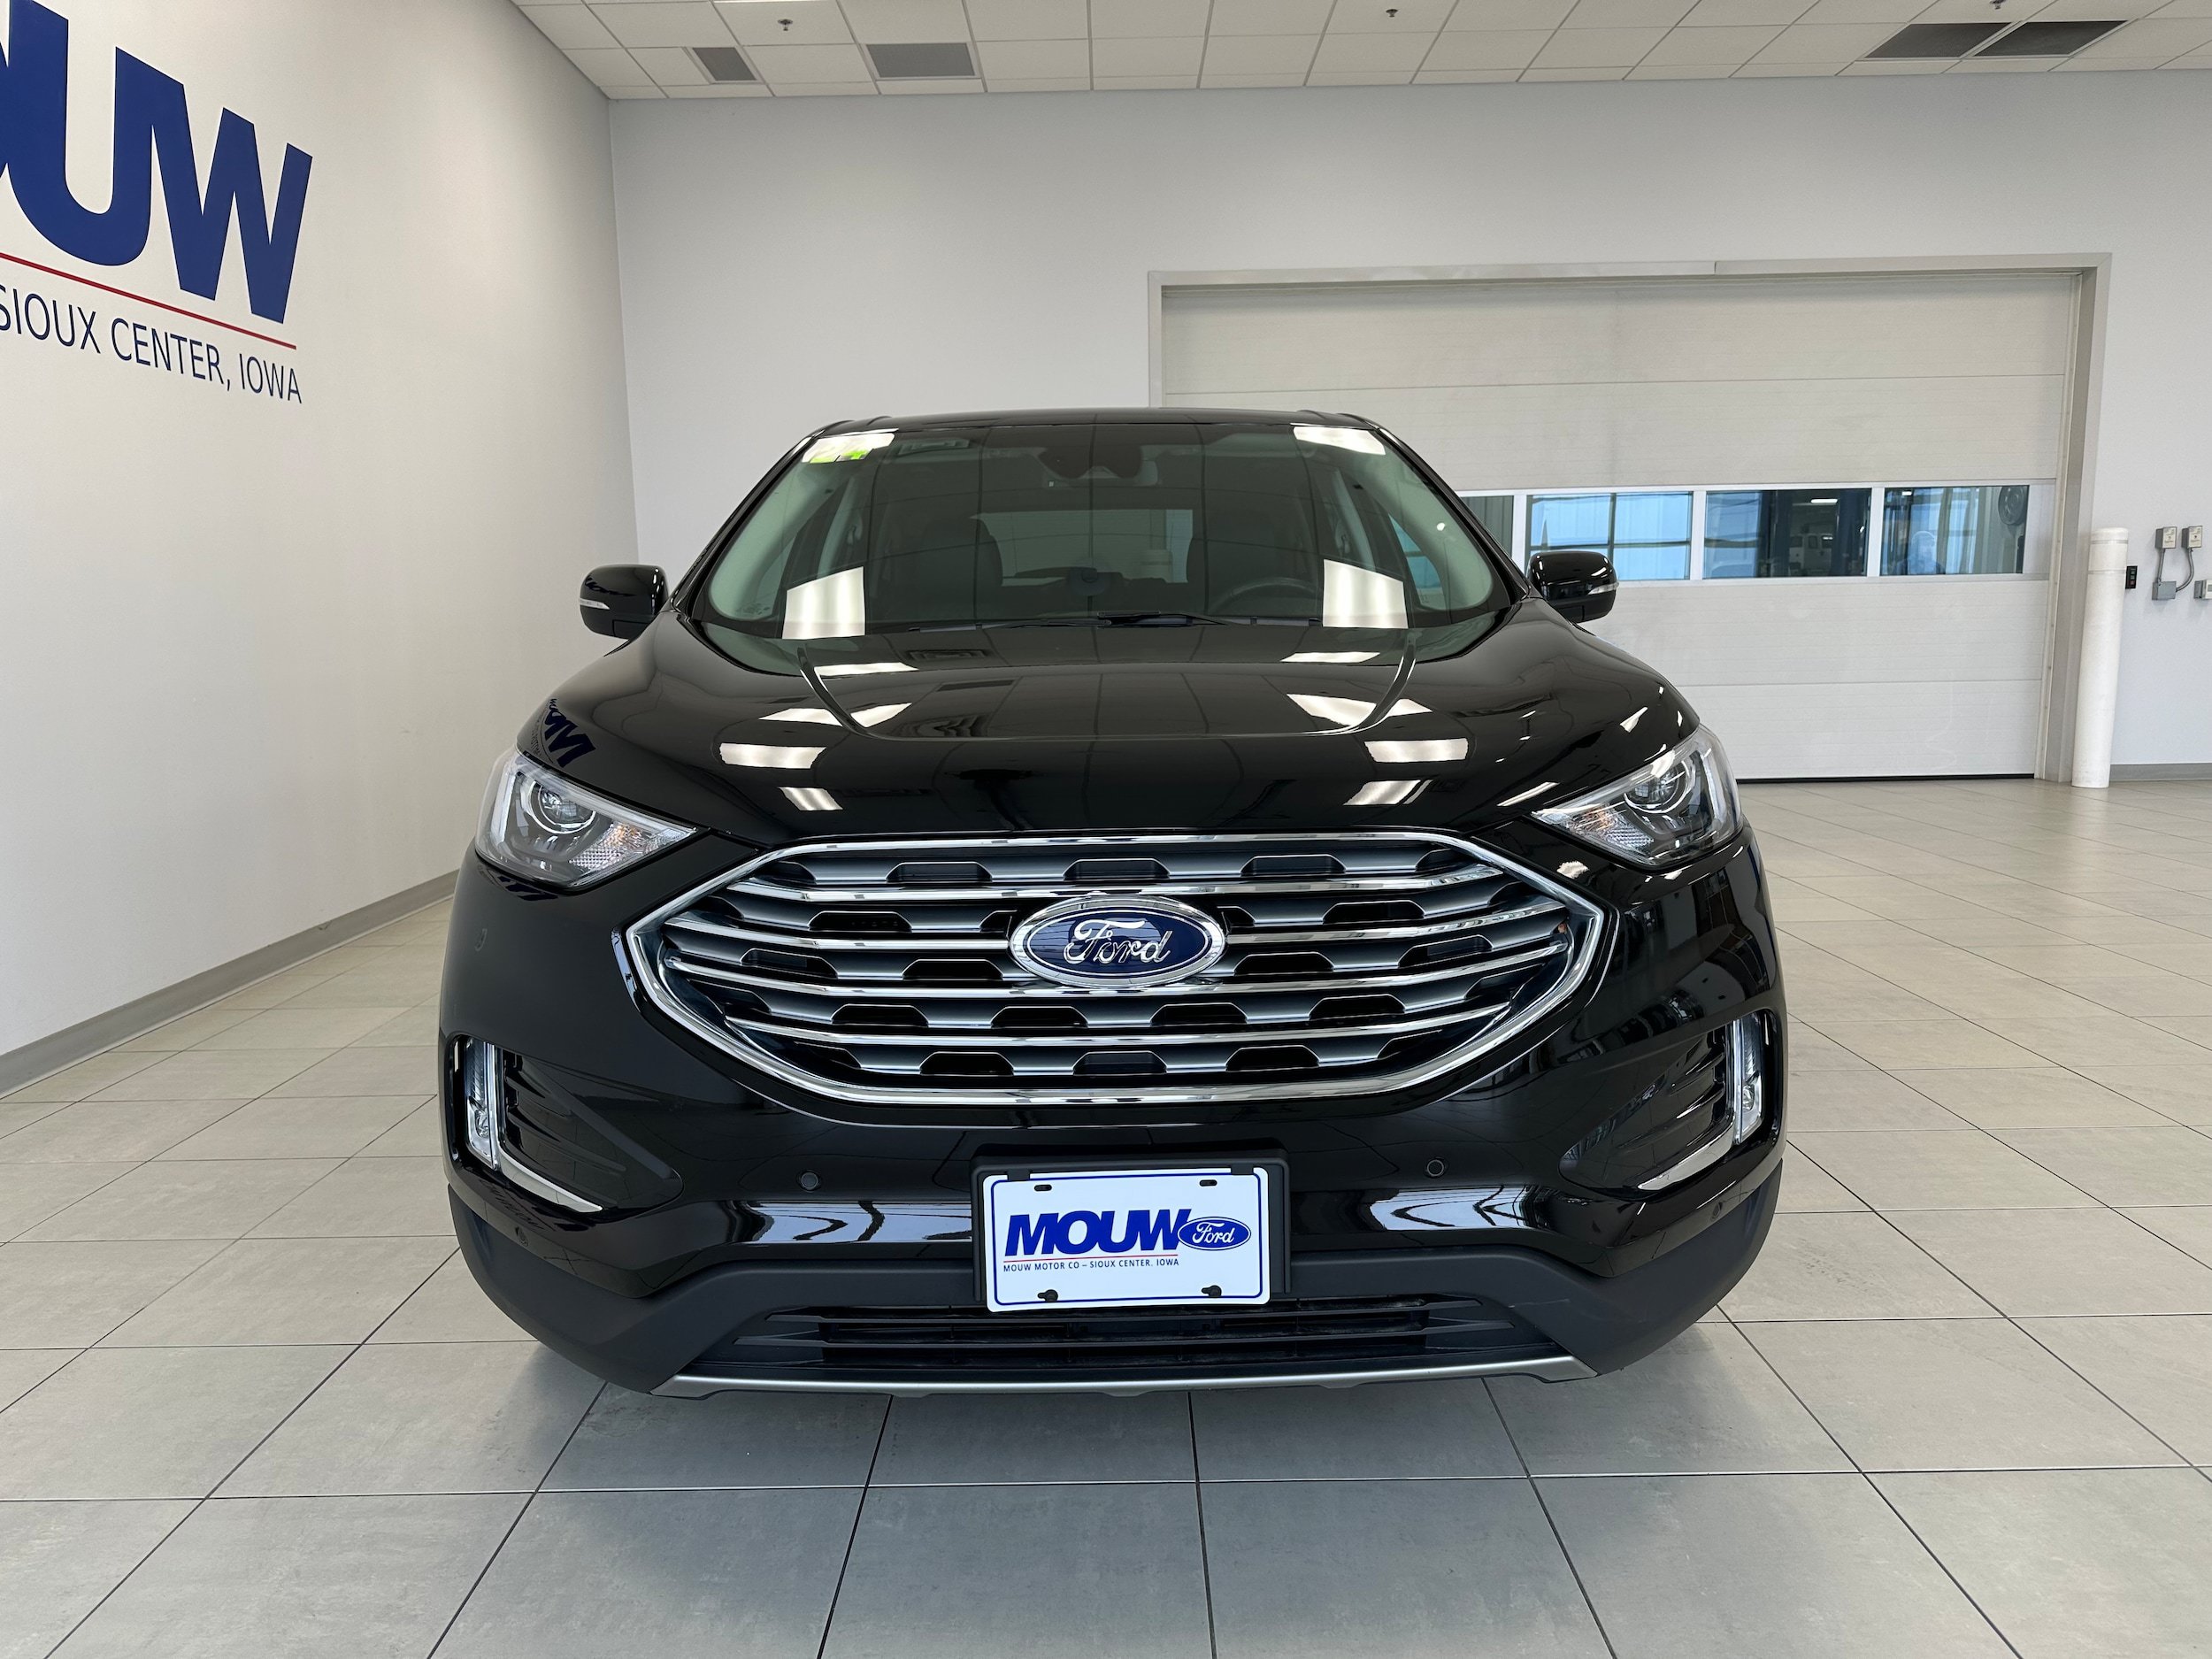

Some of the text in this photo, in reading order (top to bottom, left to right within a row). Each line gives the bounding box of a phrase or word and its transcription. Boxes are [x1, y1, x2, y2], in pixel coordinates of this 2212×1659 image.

[0, 0, 312, 323] UW
[111, 318, 231, 391] CENTER,
[239, 353, 303, 403] IOWA
[1064, 918, 1172, 964] Ford
[1004, 1209, 1235, 1256] MOUW Ford
[1003, 1263, 1032, 1272] MOUW
[1034, 1262, 1065, 1271] MOTOR
